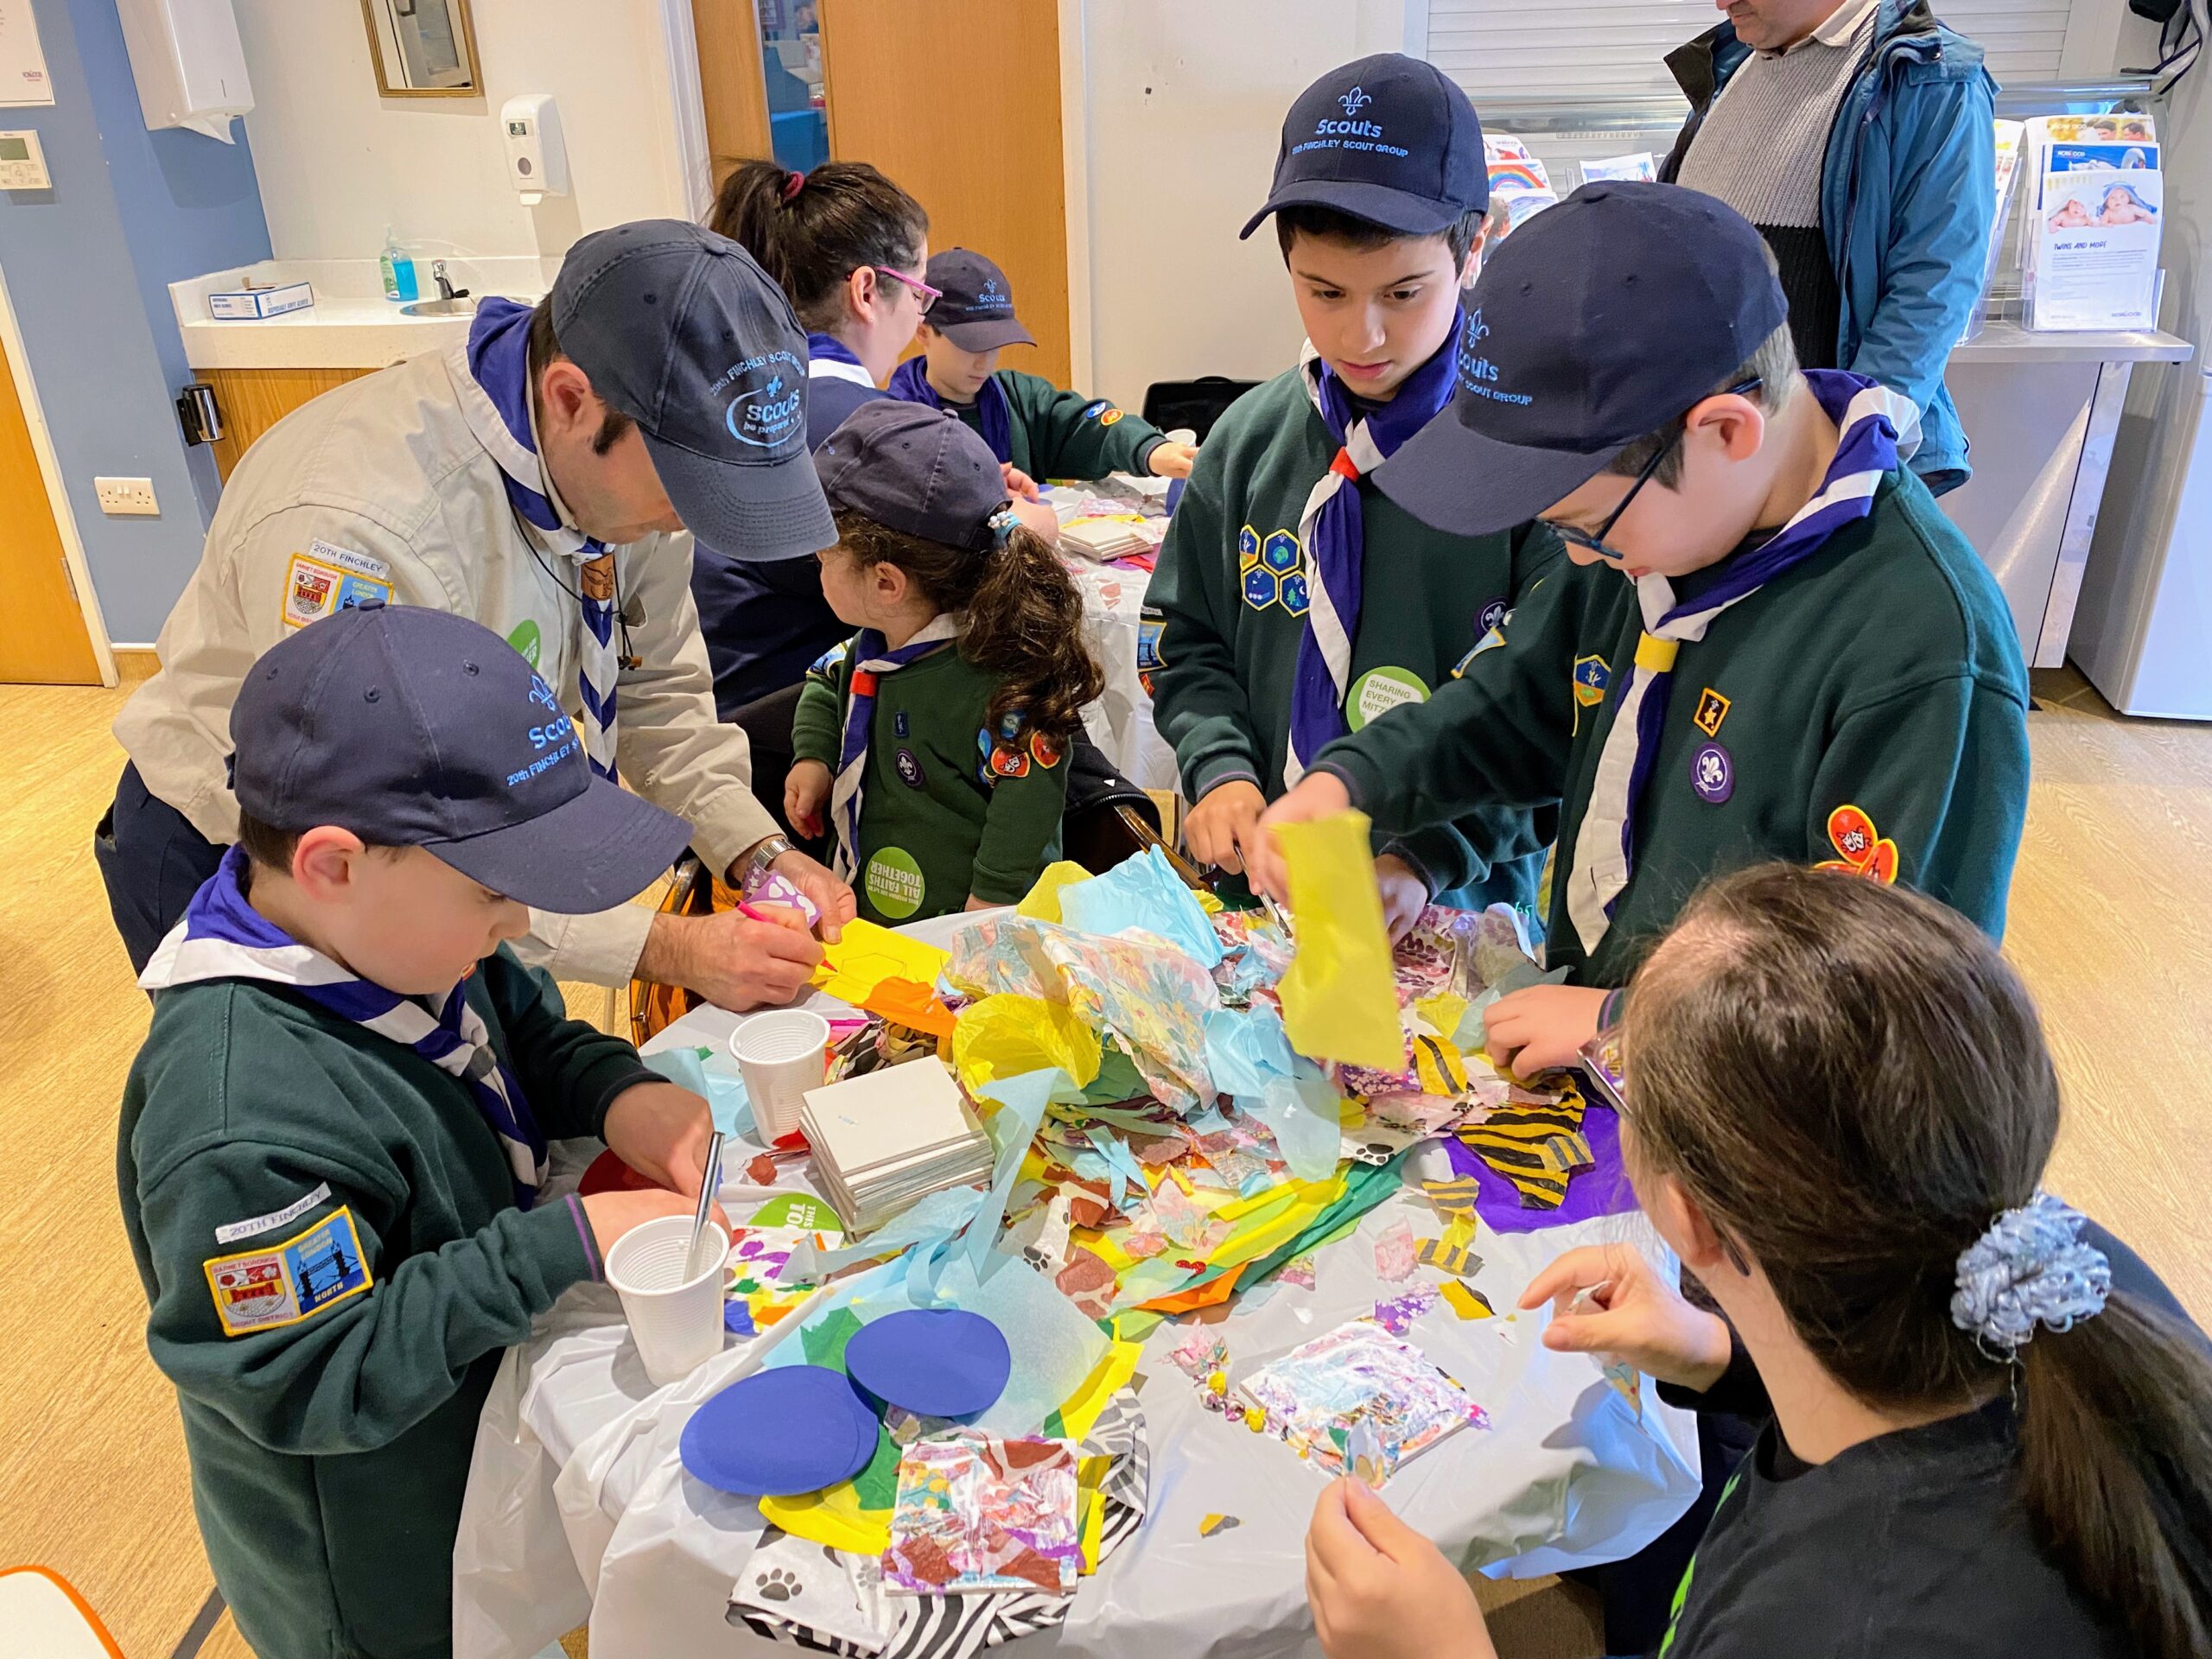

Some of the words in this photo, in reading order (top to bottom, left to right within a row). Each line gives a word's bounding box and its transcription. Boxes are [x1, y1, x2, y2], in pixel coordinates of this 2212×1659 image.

[1314, 118, 1383, 138] Scouts
[1303, 139, 1340, 151] FINCHLEY
[1343, 140, 1375, 151] SCOUT
[1376, 144, 1409, 157] GROUP
[727, 356, 767, 380] FINCHLEY
[769, 351, 791, 363] SCOUT
[1493, 391, 1533, 405] GROUP
[313, 543, 338, 558] 20TH
[340, 554, 384, 572] FINCHLEY
[1366, 690, 1396, 706] EVERY
[1369, 679, 1411, 699] SHARING
[1362, 701, 1387, 714] MITZ
[506, 768, 531, 786] 20th
[529, 743, 570, 777] FINCHLEY
[869, 874, 899, 893] FAITHS
[871, 861, 921, 887] TOGETHER
[904, 885, 921, 899] ALL
[804, 1205, 816, 1228] THIS
[230, 1220, 267, 1236] 20TH
[315, 1281, 344, 1303] NORTH
